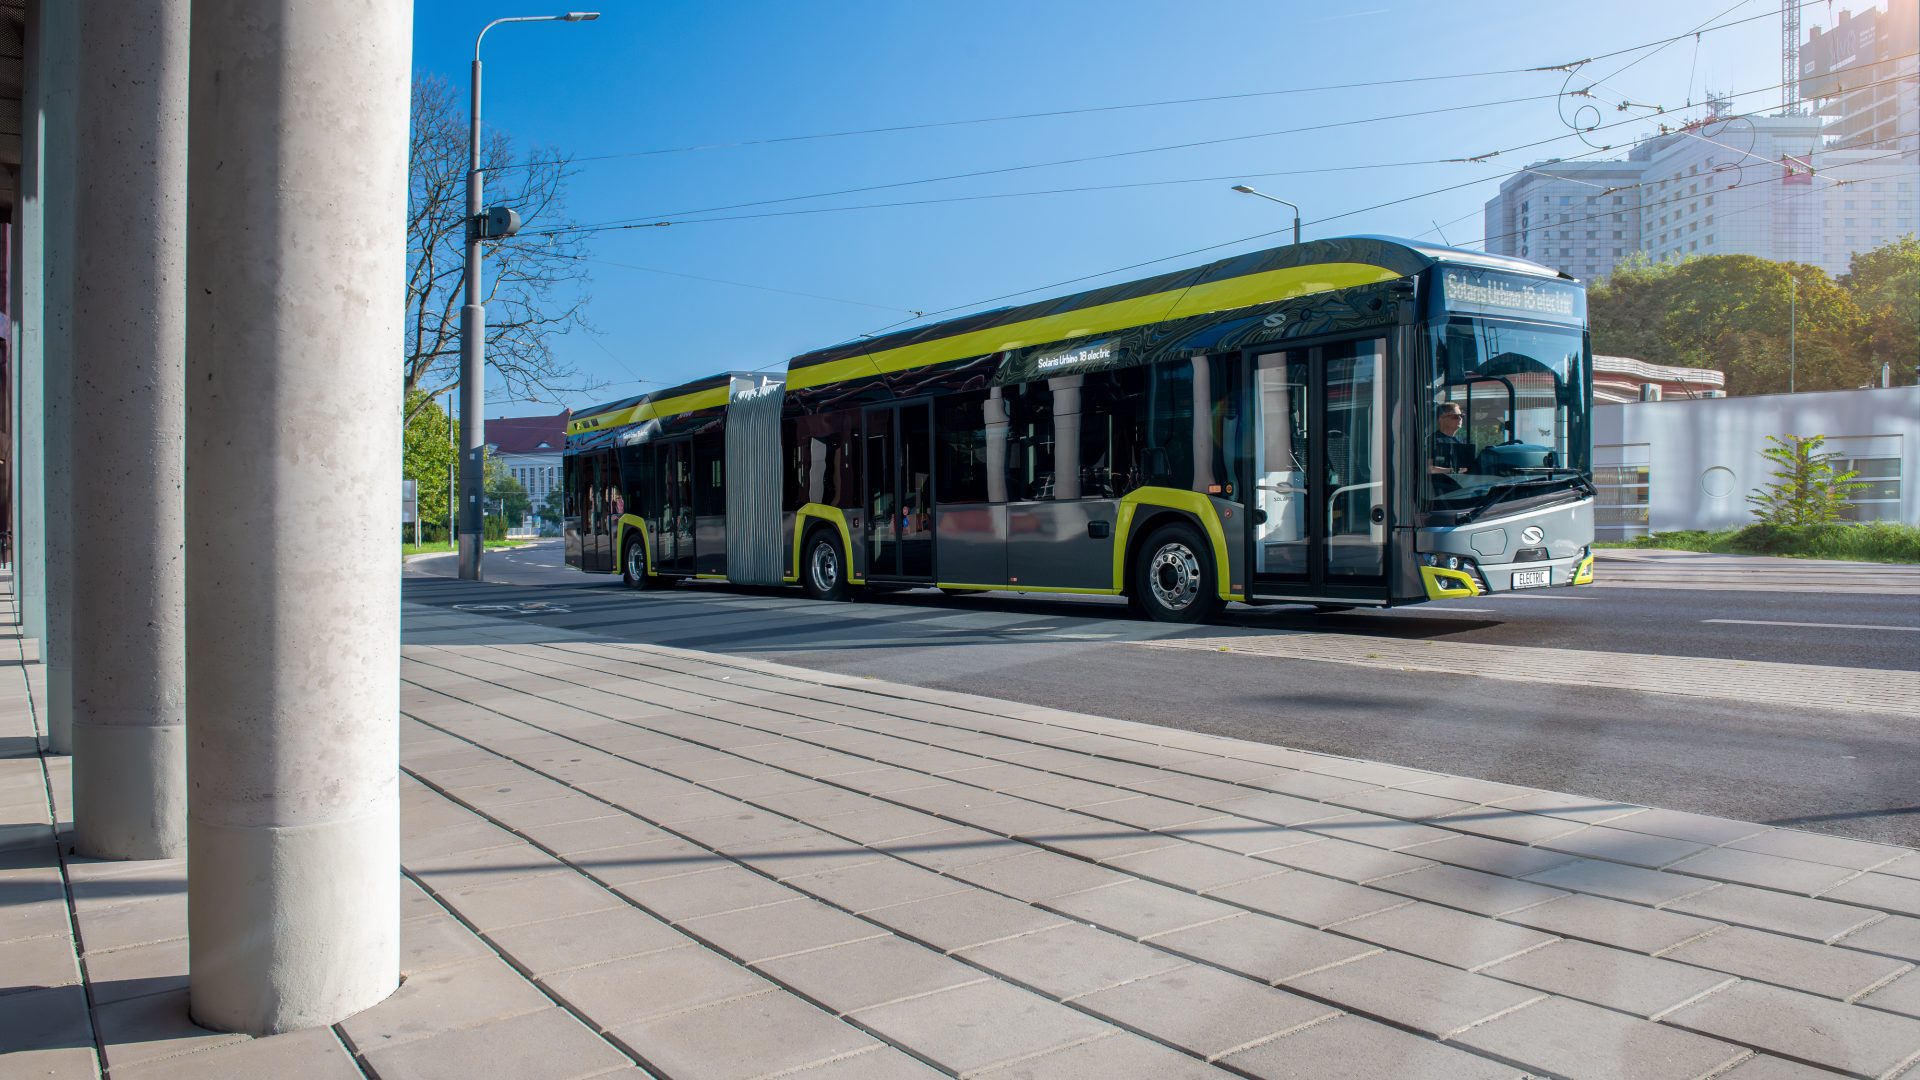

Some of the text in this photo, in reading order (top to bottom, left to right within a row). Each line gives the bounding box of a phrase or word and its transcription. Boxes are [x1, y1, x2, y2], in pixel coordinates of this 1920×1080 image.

[1522, 285, 1536, 309] 18
[1038, 349, 1110, 368] Solaris Urbino 18 electric
[1519, 572, 1545, 584] ELECTRIC
